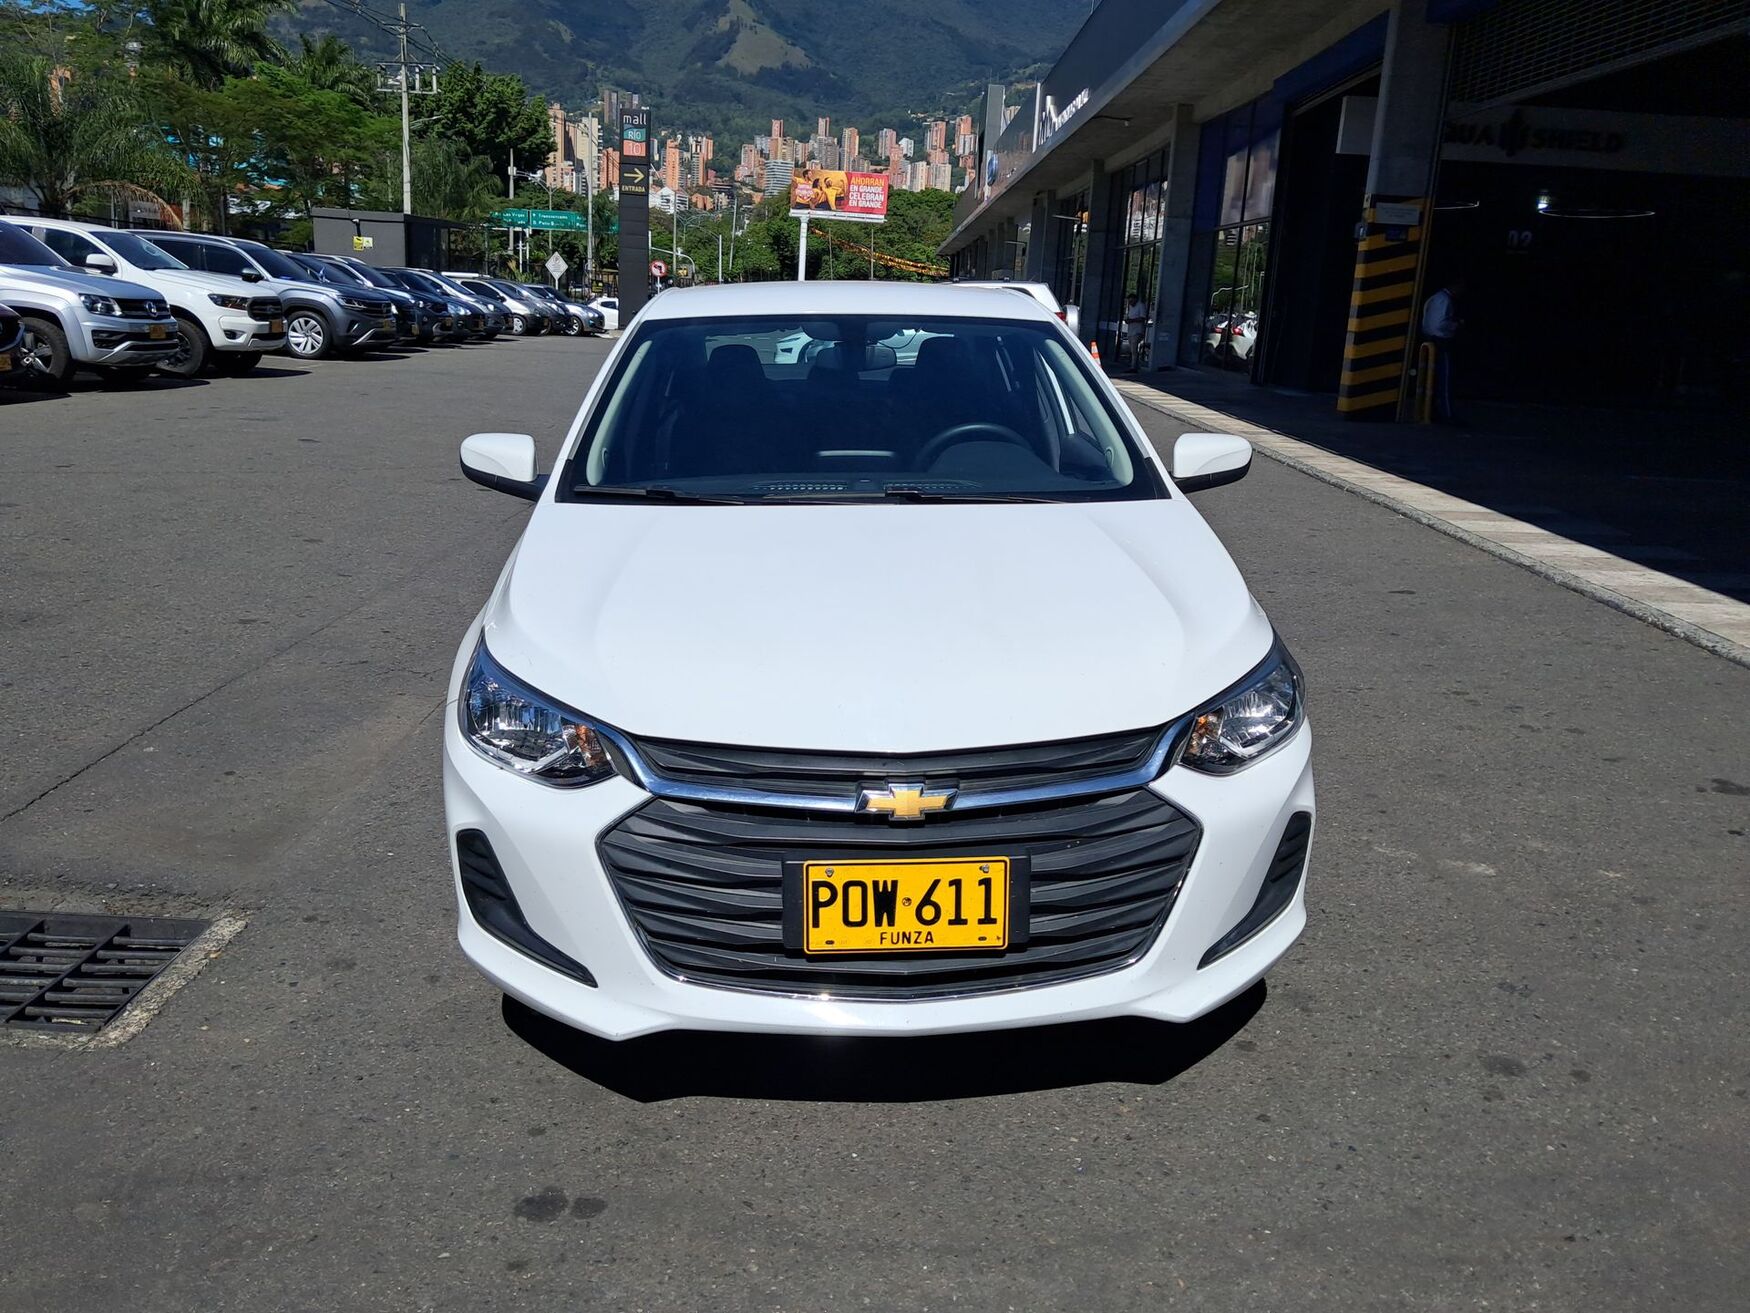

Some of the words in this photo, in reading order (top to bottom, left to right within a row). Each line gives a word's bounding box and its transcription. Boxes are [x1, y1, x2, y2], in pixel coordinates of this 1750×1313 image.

[623, 112, 647, 125] mall
[1530, 128, 1624, 153] SHIELD
[629, 143, 642, 156] 10
[850, 176, 884, 187] AHORRAN
[621, 185, 645, 193] ENTRADA
[850, 184, 858, 192] EN
[849, 192, 884, 202] CELEBRAN
[849, 199, 857, 207] EN
[811, 879, 899, 929] POW
[914, 877, 998, 927] 611
[879, 931, 934, 945] FUNZA
